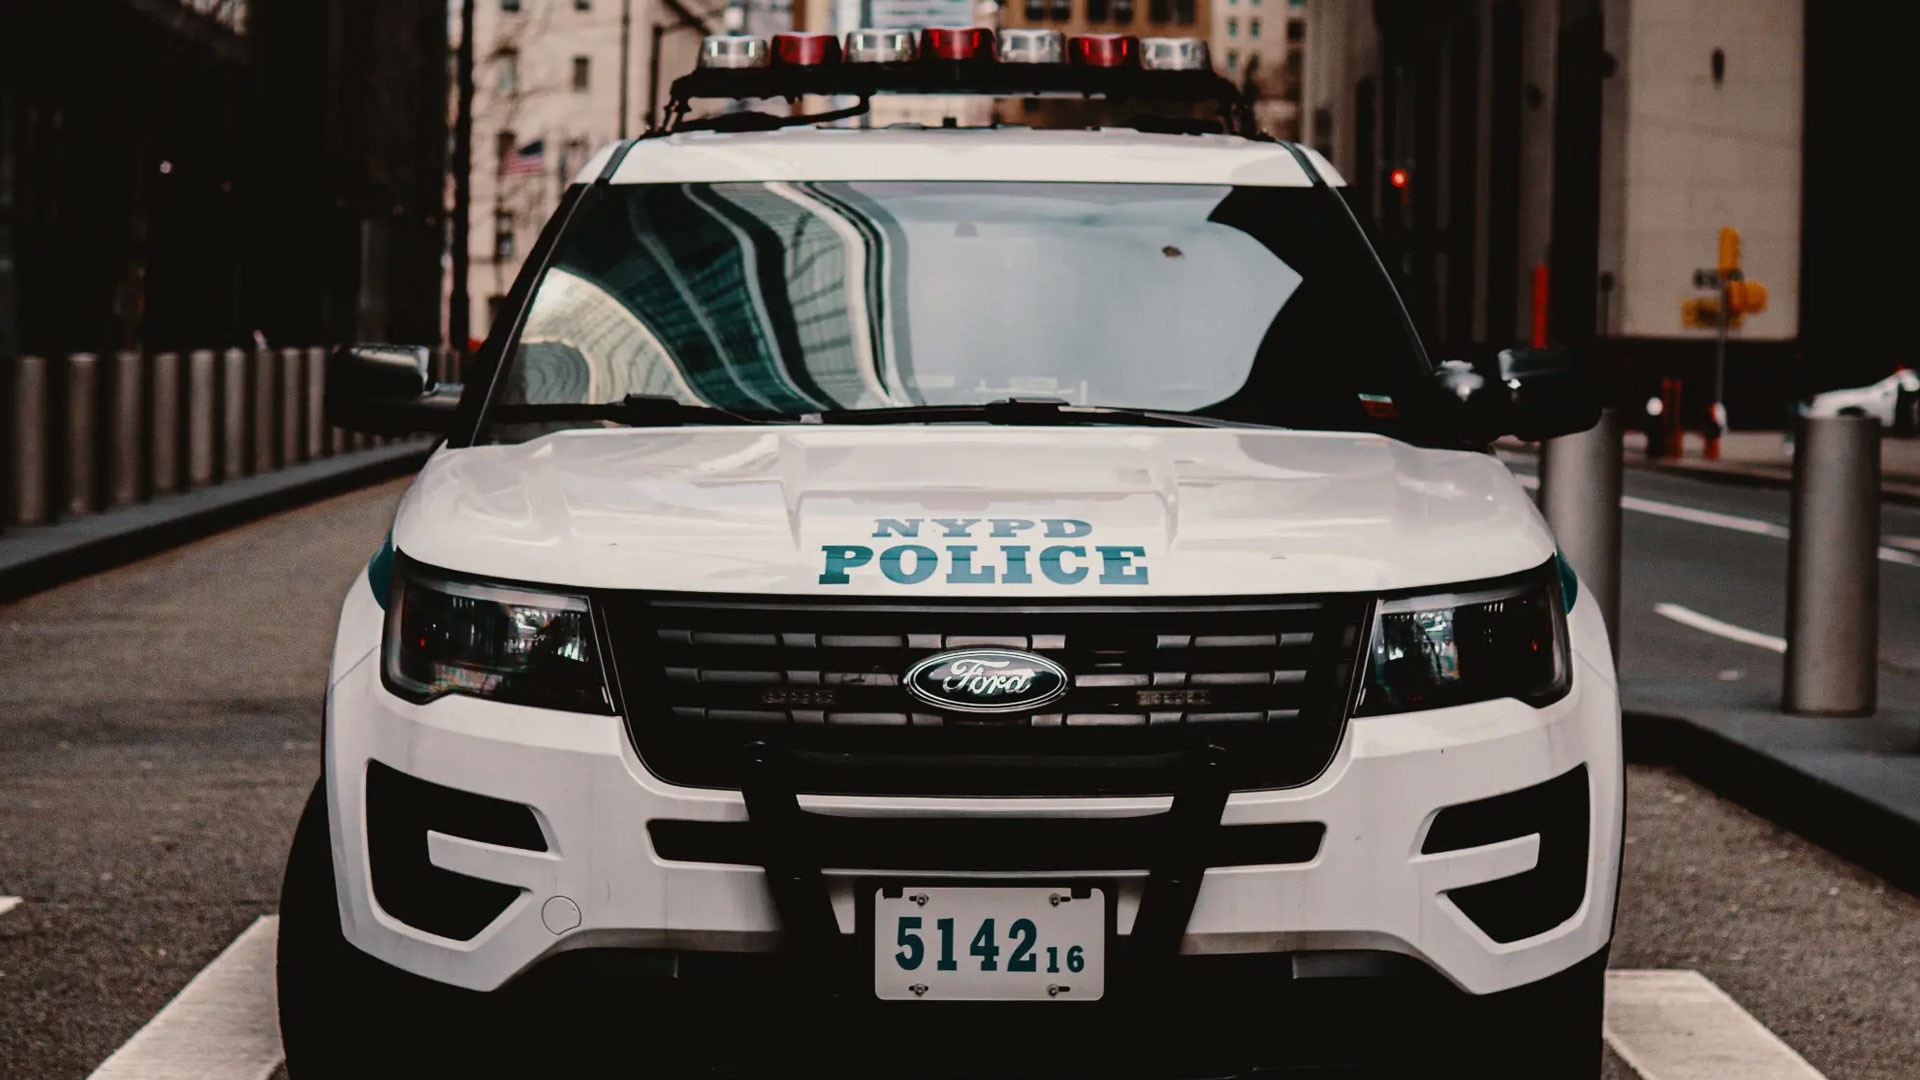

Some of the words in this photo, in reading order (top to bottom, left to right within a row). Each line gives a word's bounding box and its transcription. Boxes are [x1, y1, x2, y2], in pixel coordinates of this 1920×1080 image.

[871, 518, 1093, 538] NYPD
[818, 544, 1149, 585] POLICE
[942, 659, 1034, 694] Ford
[895, 916, 1037, 972] 5142
[1046, 945, 1085, 973] 16
